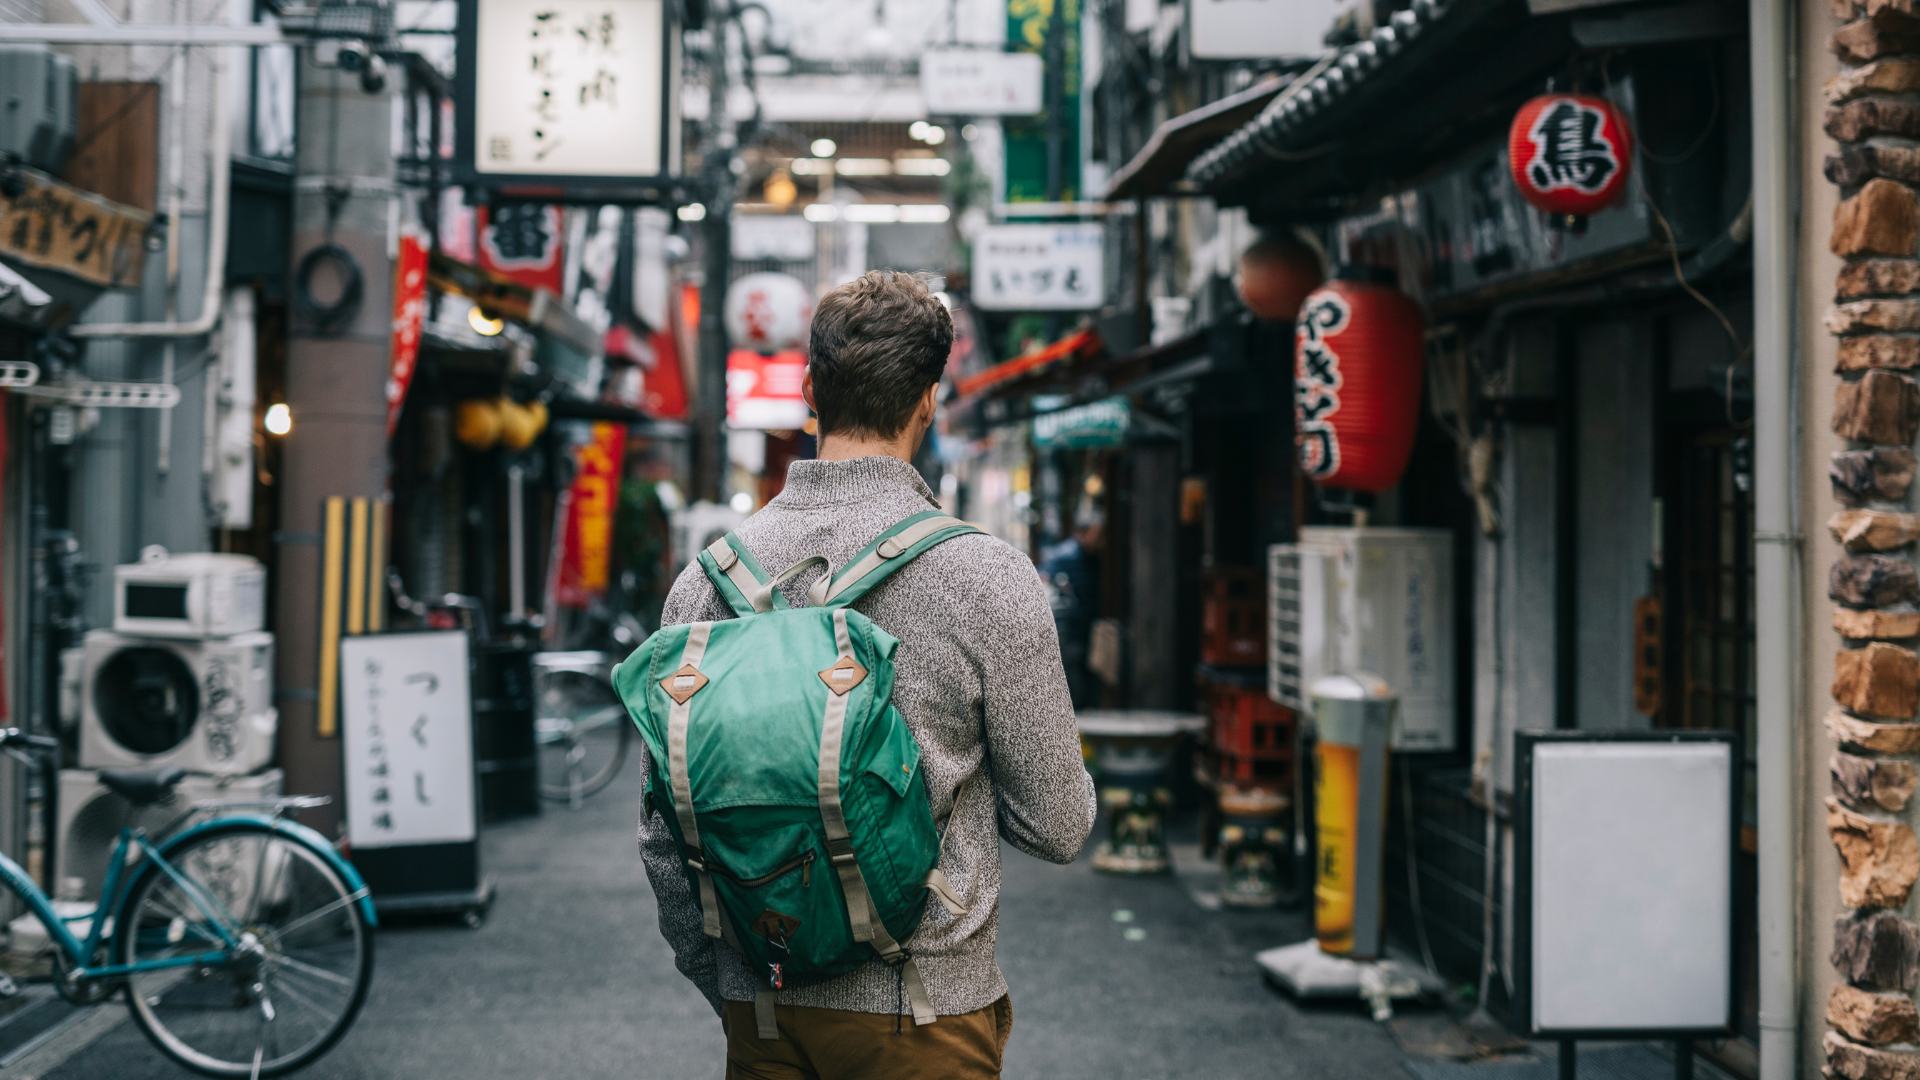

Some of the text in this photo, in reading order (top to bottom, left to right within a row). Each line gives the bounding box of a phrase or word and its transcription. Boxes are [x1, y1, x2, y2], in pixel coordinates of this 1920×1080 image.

[576, 11, 622, 108] 焼肉
[404, 671, 439, 805] つくし
